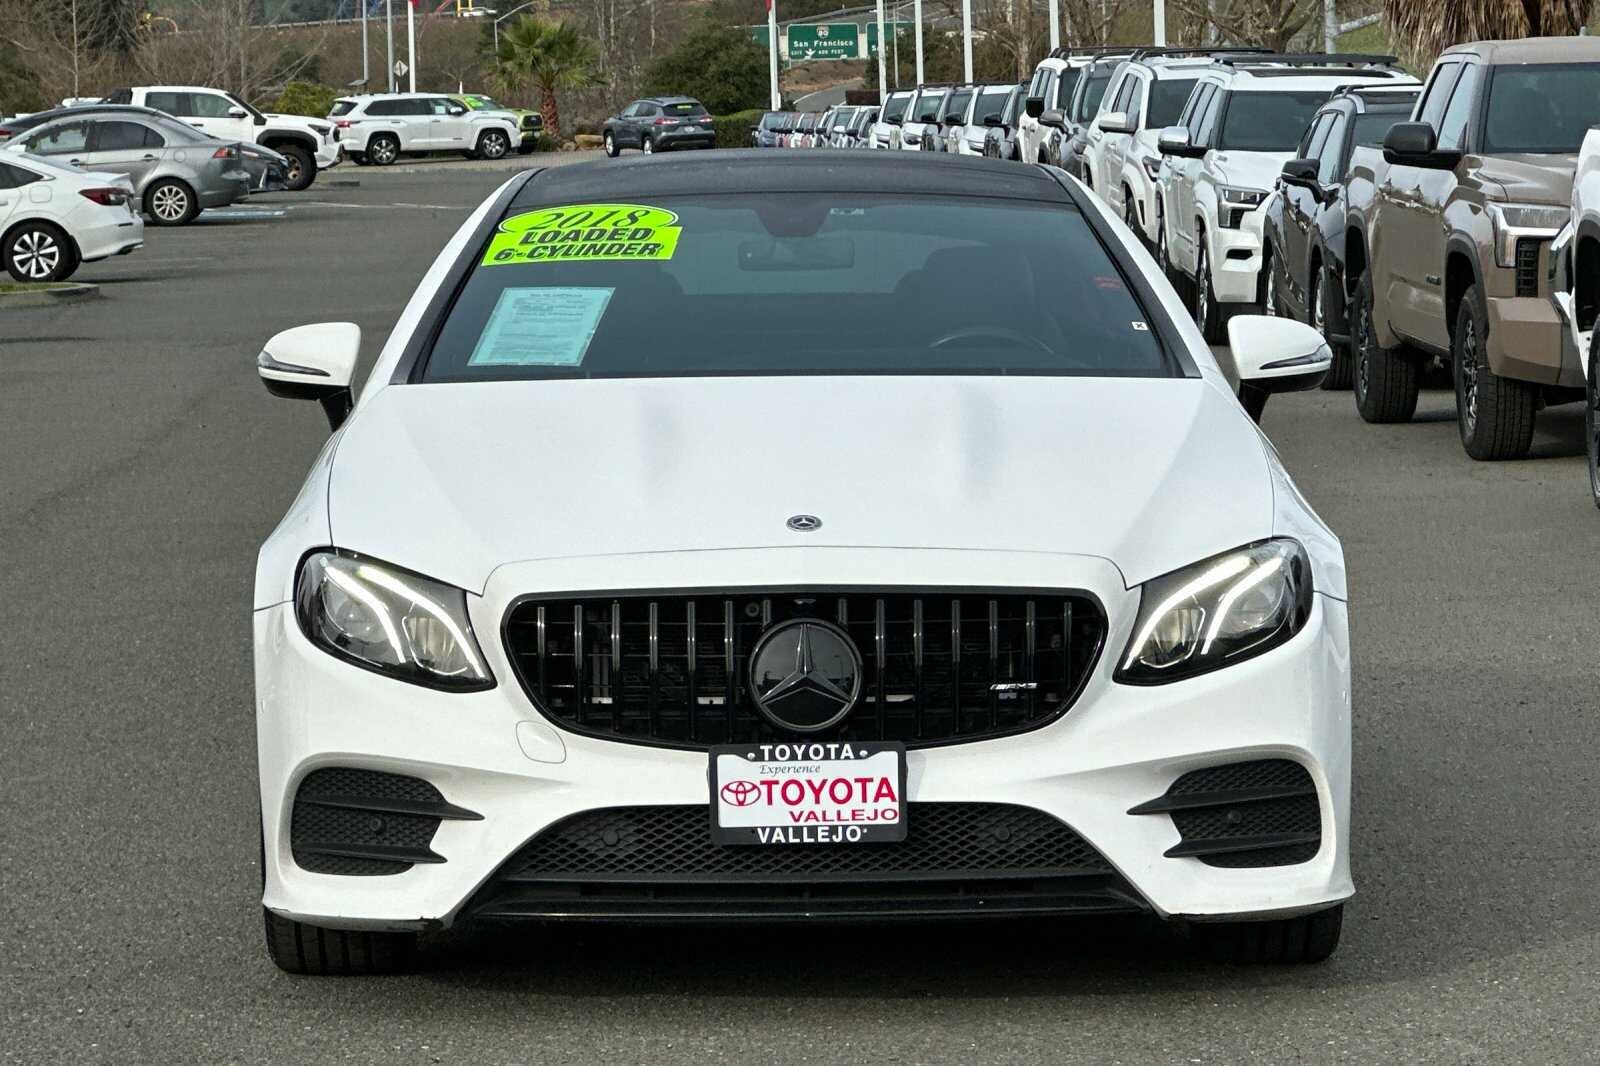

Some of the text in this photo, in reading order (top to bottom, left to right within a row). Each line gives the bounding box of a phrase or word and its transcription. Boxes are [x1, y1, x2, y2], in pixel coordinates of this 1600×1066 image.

[528, 210, 650, 229] 2018
[519, 228, 655, 246] LOADED
[494, 243, 665, 261] 6-CYLINDER
[760, 743, 855, 761] TOYOTA
[759, 764, 821, 776] Experience
[760, 777, 897, 806] TOYOTA
[789, 808, 898, 823] VALLEJO
[757, 825, 862, 844] VALLEJO
